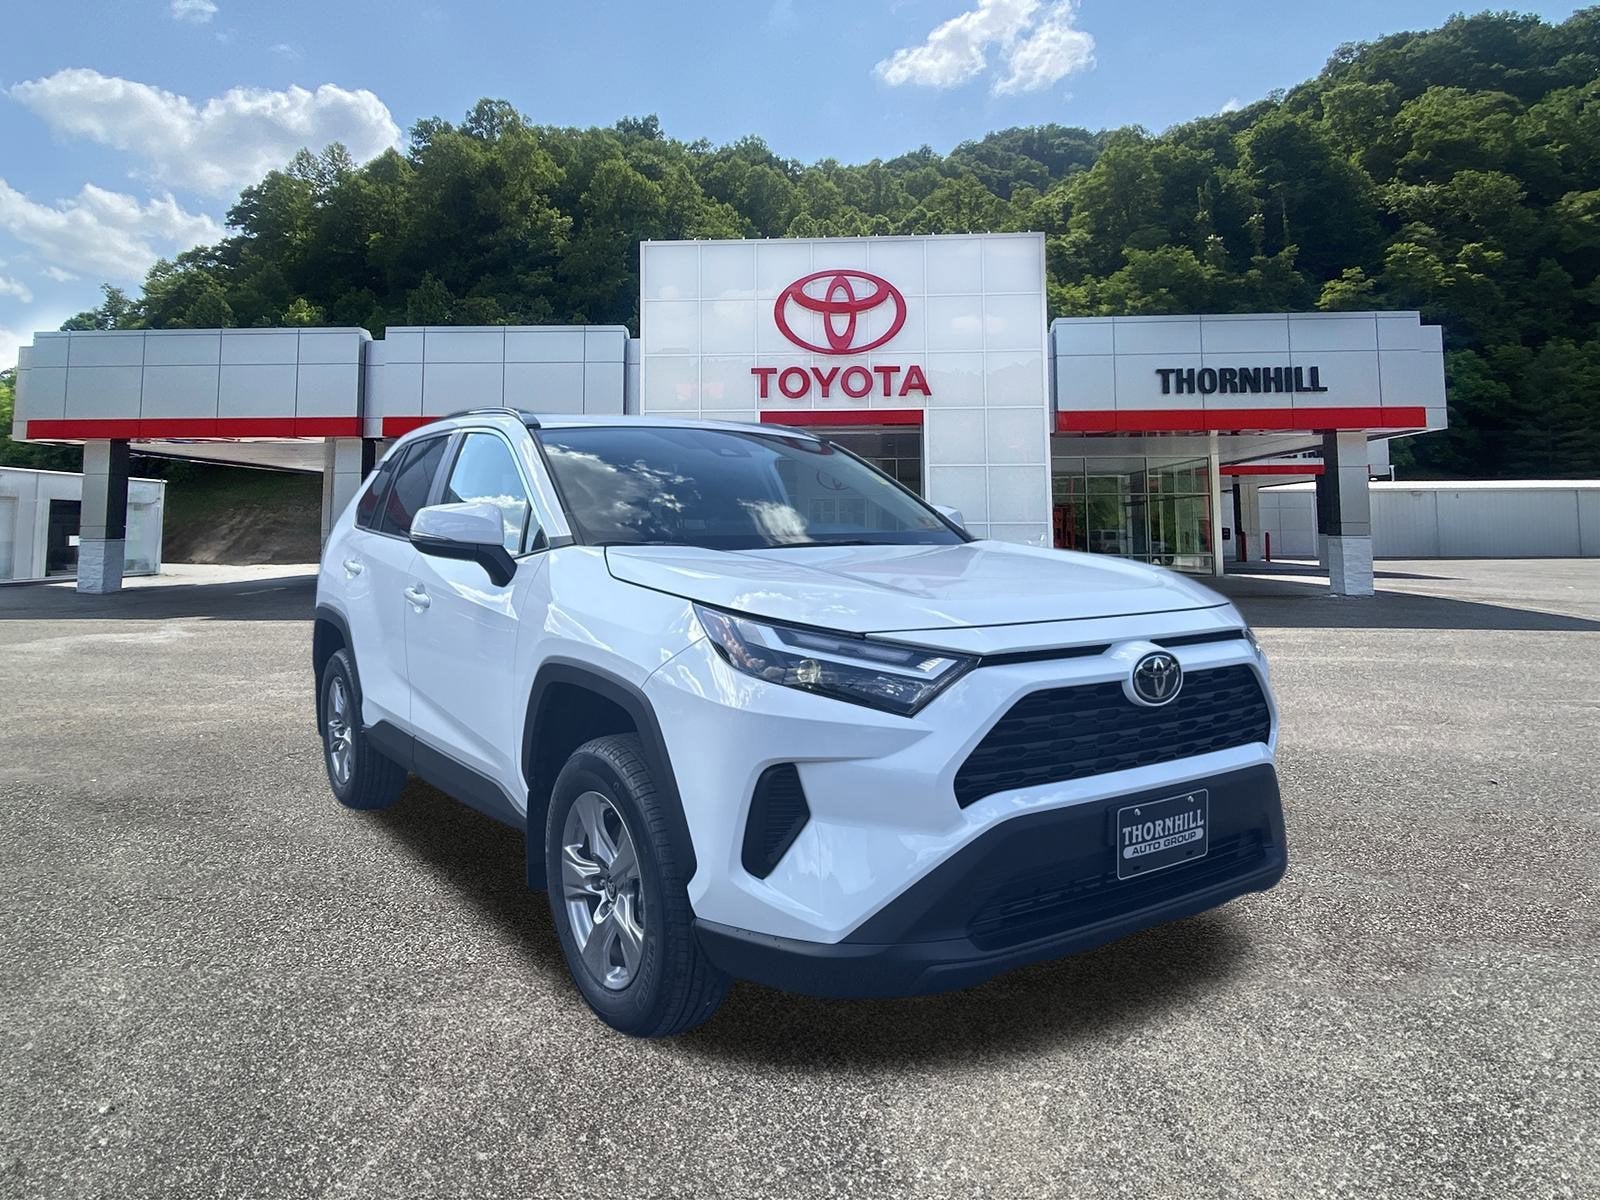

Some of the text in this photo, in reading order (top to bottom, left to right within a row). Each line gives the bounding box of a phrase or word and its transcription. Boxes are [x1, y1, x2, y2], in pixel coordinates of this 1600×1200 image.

[751, 365, 932, 399] TOYOTA
[1156, 366, 1328, 395] THORNHILL
[1122, 809, 1204, 845] THORNHILL
[1132, 831, 1196, 856] AUTO GROUP
